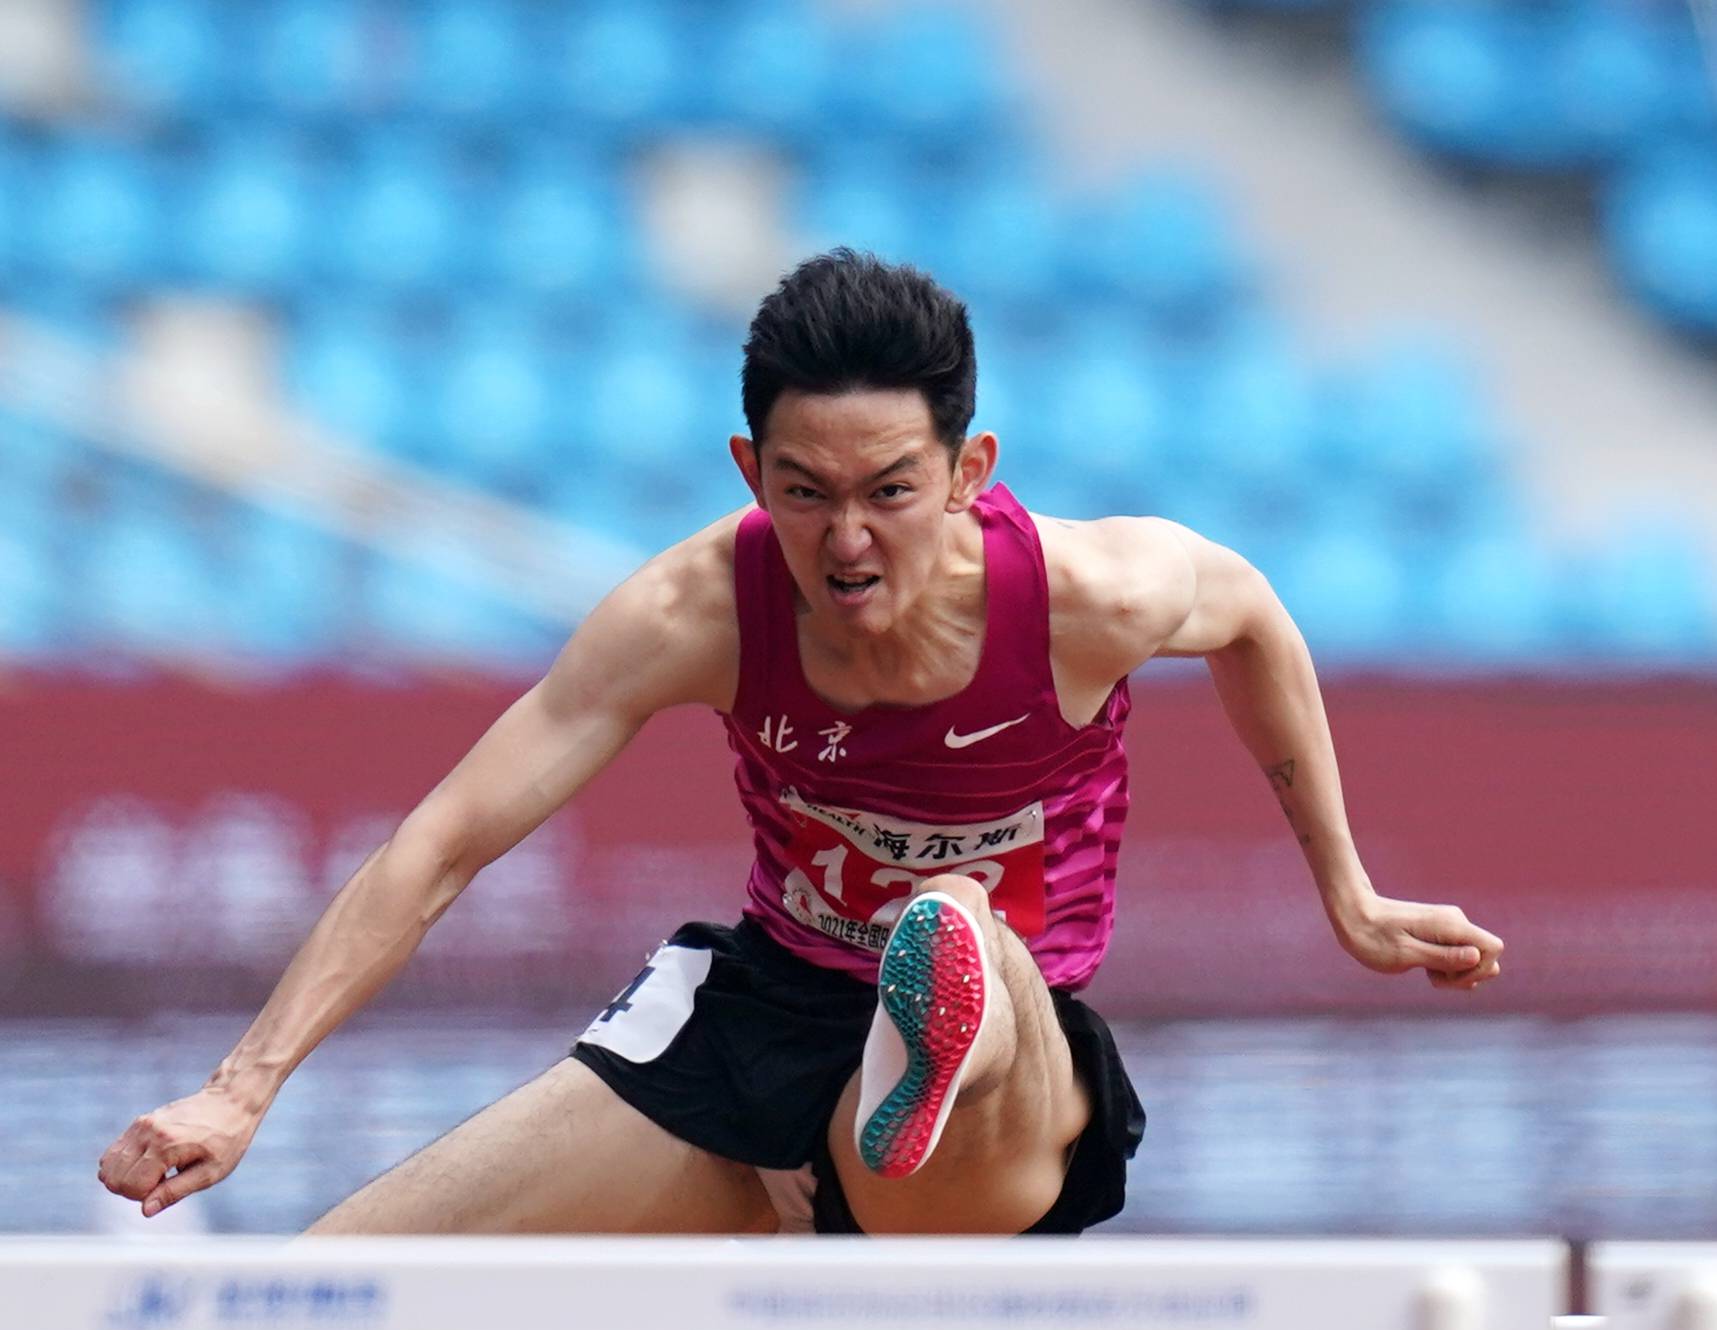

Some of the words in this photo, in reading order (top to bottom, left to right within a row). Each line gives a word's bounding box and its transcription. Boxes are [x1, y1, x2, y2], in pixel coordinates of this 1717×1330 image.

[757, 714, 853, 764] 北京
[873, 824, 1019, 860] 海尔斯
